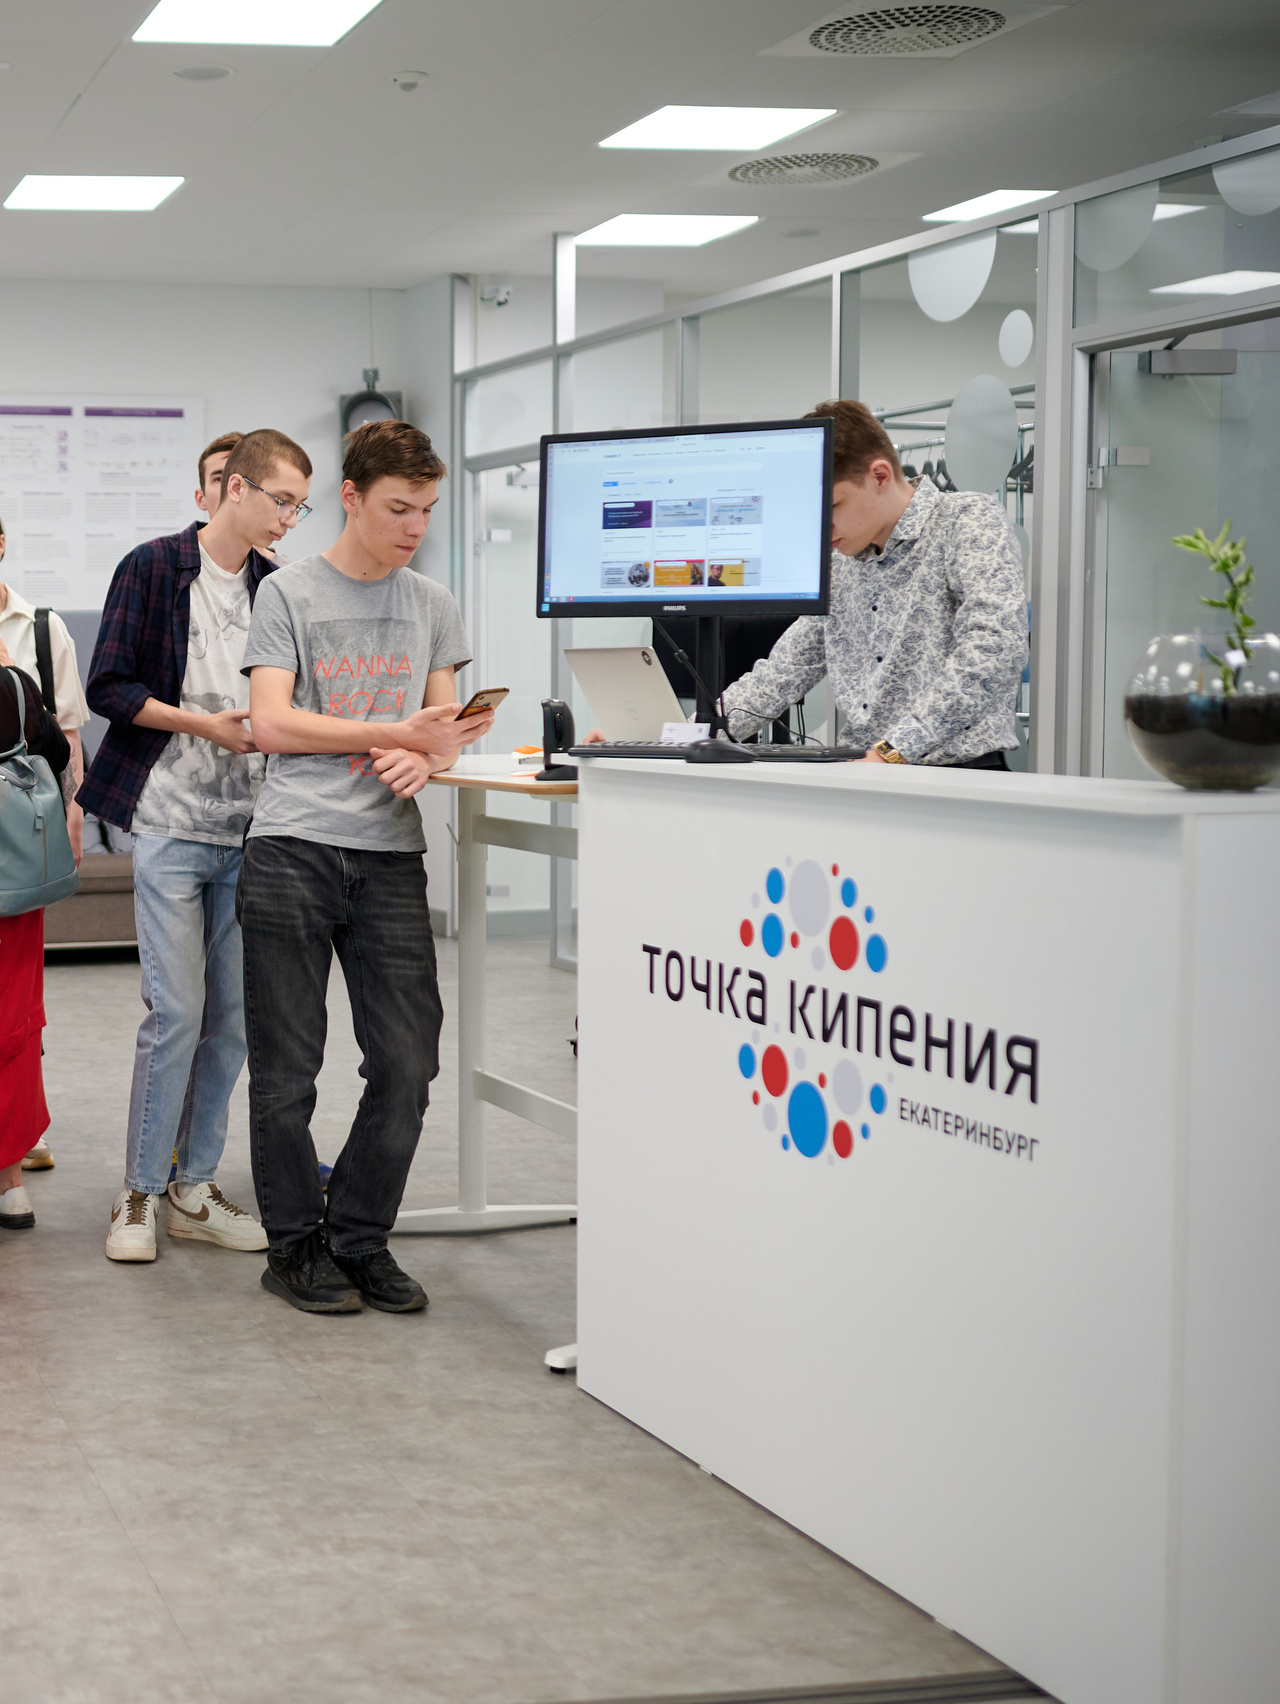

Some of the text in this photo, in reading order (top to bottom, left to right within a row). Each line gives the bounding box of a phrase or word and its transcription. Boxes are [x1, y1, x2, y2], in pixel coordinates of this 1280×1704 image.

[328, 688, 407, 717] ROCK
[348, 753, 375, 777] YO
[899, 1096, 1041, 1162] ЕКАТЕРИНБУРГ
